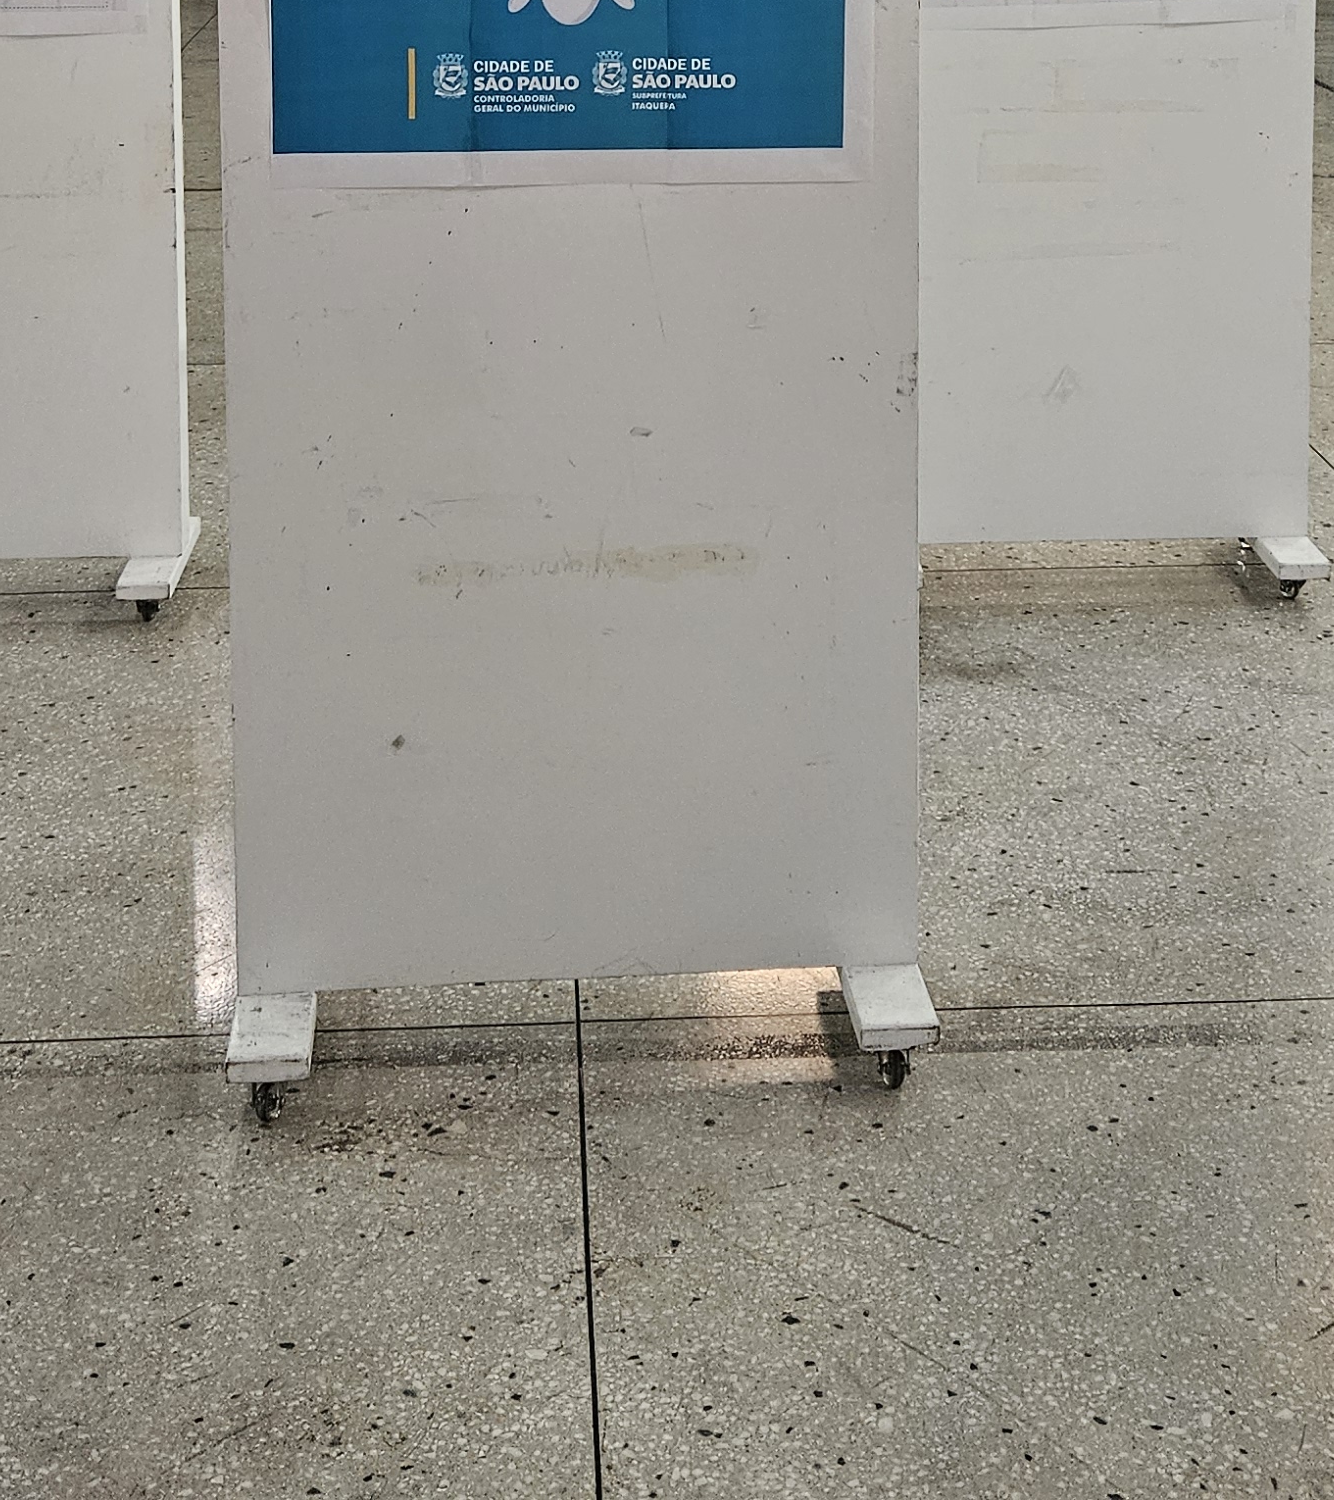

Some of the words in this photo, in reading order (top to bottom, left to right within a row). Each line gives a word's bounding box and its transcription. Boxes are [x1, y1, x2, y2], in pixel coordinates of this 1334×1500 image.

[473, 60, 530, 73] CIDADE
[533, 59, 554, 72] DE
[631, 57, 687, 71] CIDADE
[691, 57, 711, 70] DE
[473, 74, 513, 91] SÃO
[517, 75, 579, 91] PAULO
[631, 72, 671, 89] SÃO
[674, 73, 736, 89] PAULO
[473, 94, 555, 103] CONTROLADORIA
[631, 91, 687, 99] SUBPREFETURA
[473, 104, 504, 113] GERAL
[505, 104, 522, 112] DO
[523, 103, 575, 112] MUNICÍPIO
